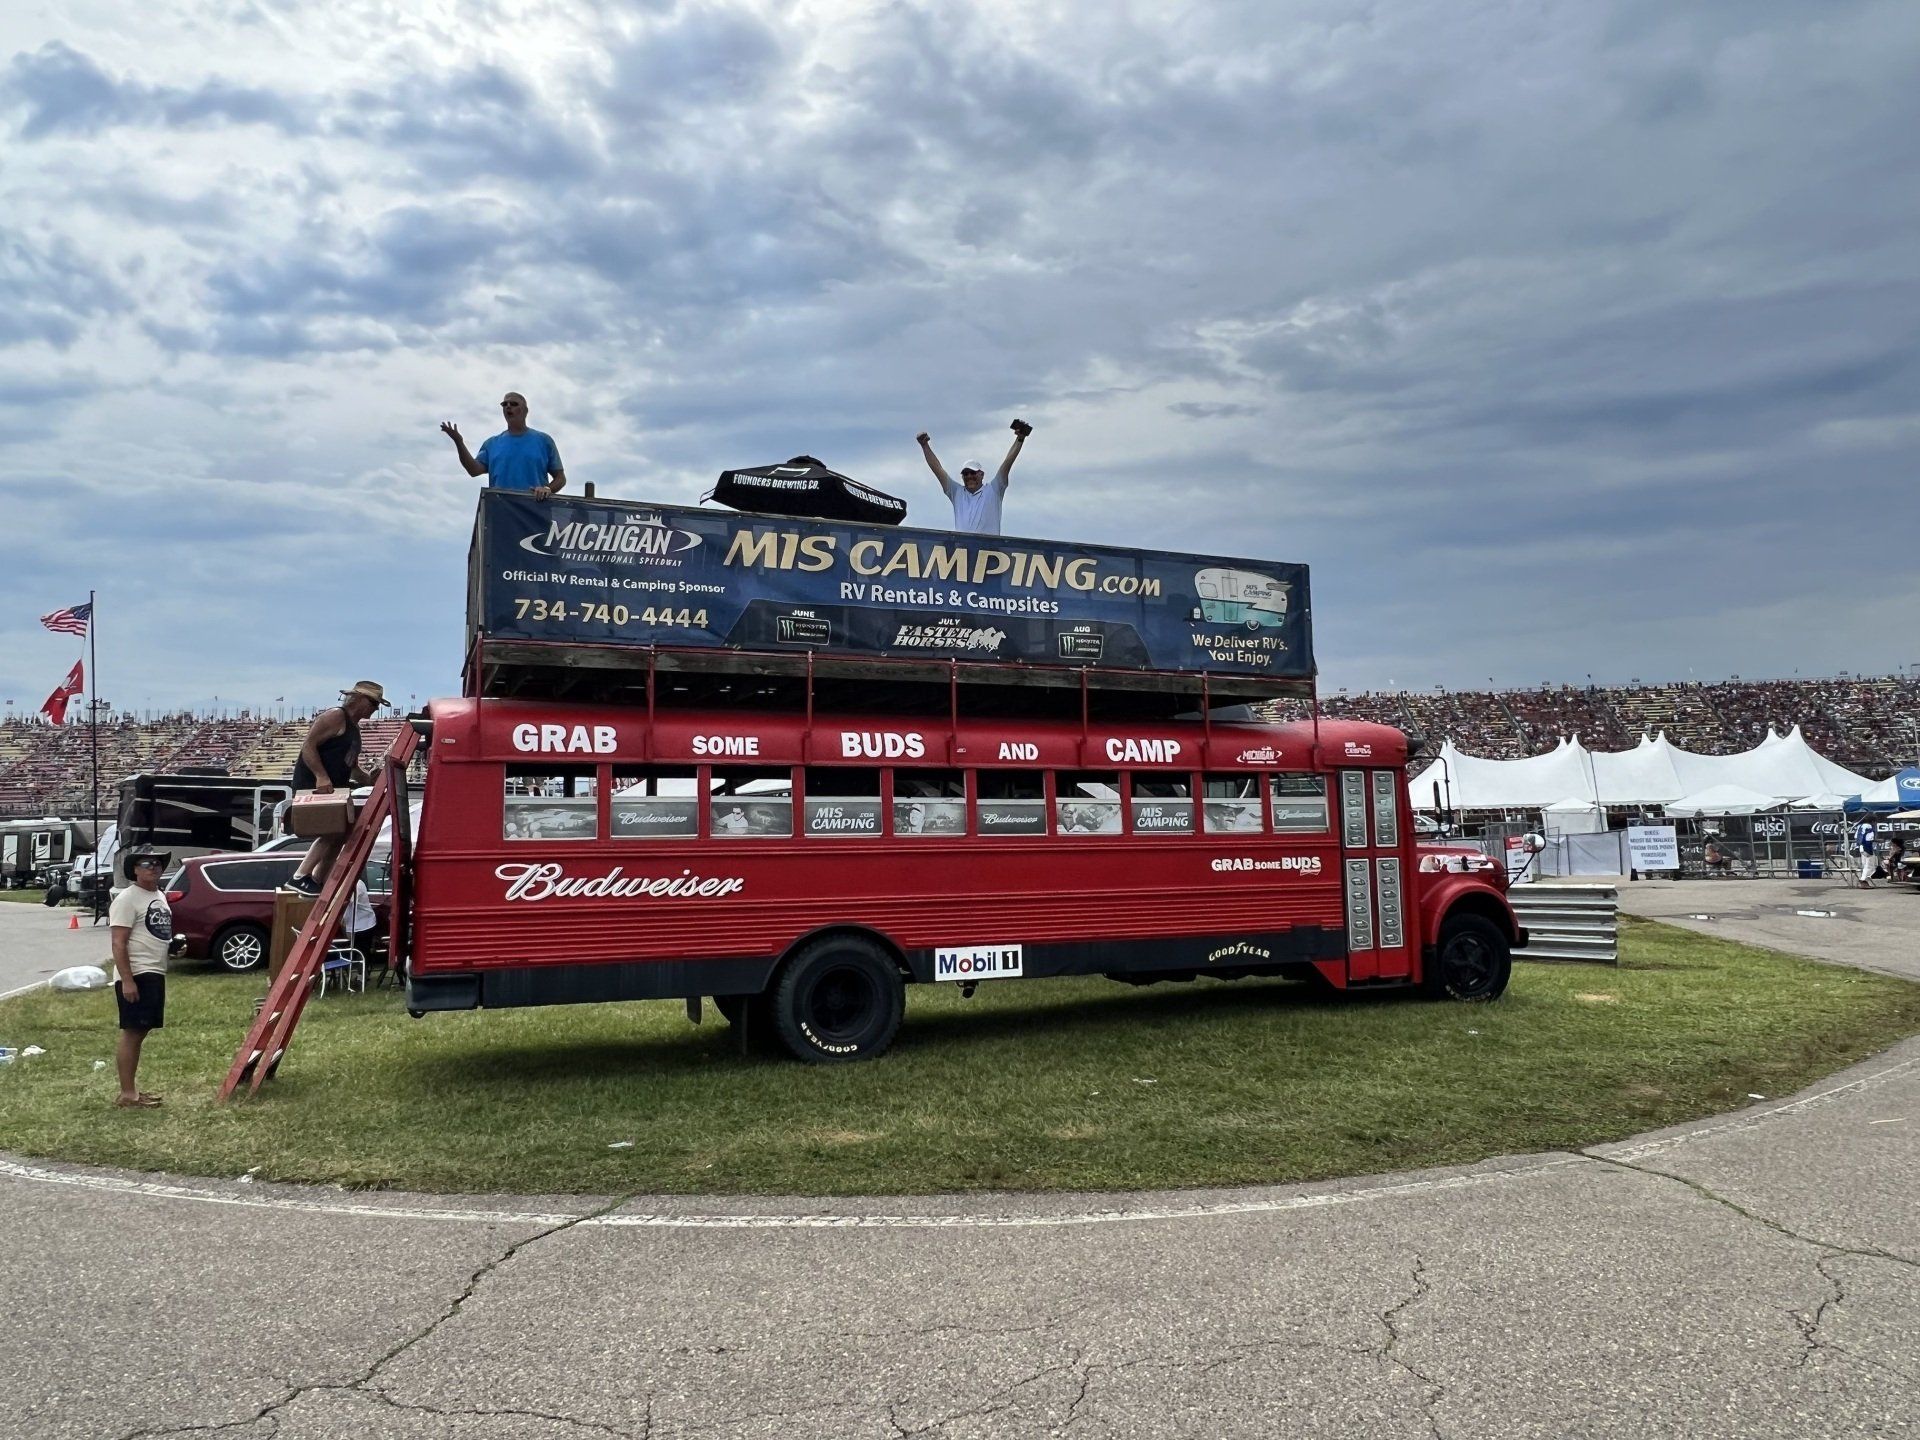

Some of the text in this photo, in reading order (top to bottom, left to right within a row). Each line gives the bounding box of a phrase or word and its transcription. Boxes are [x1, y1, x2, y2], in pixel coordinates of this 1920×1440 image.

[733, 473, 820, 490] FOUNDERS BREWING CO.
[545, 520, 674, 555] MICHIGAN
[723, 529, 836, 572] MIS
[561, 552, 683, 567] INTERNATIONAL SPEEDWAY
[502, 570, 726, 594] Official RV Rental & Camping Sponsor
[840, 582, 1059, 614] RV Rentals & Campsites
[514, 598, 709, 629] 734-740-4444
[792, 609, 815, 618] JUNE
[897, 625, 973, 638] FASTER
[892, 635, 969, 648] HORSES
[1192, 634, 1288, 651] We Deliver RV's.
[1208, 649, 1272, 667] You Enjoy.
[512, 723, 1181, 763] GRAB SOME BUDS AND CAMP
[1242, 750, 1275, 760] MICHIGAN
[618, 812, 688, 825] Budweiser
[816, 807, 844, 818] MIS
[983, 813, 1038, 825] Budweiser
[1140, 807, 1163, 817] MIS
[811, 818, 875, 830] CAMPING
[1137, 816, 1189, 828] CAMPING
[1876, 822, 1920, 832] GEIC
[1211, 856, 1321, 872] GRAB SOME BUDS
[495, 863, 744, 901] Budweiser
[1208, 942, 1271, 961] GOODYEAR
[938, 951, 1017, 975] Mobil 1
[801, 1022, 858, 1053] GOODYEAR
